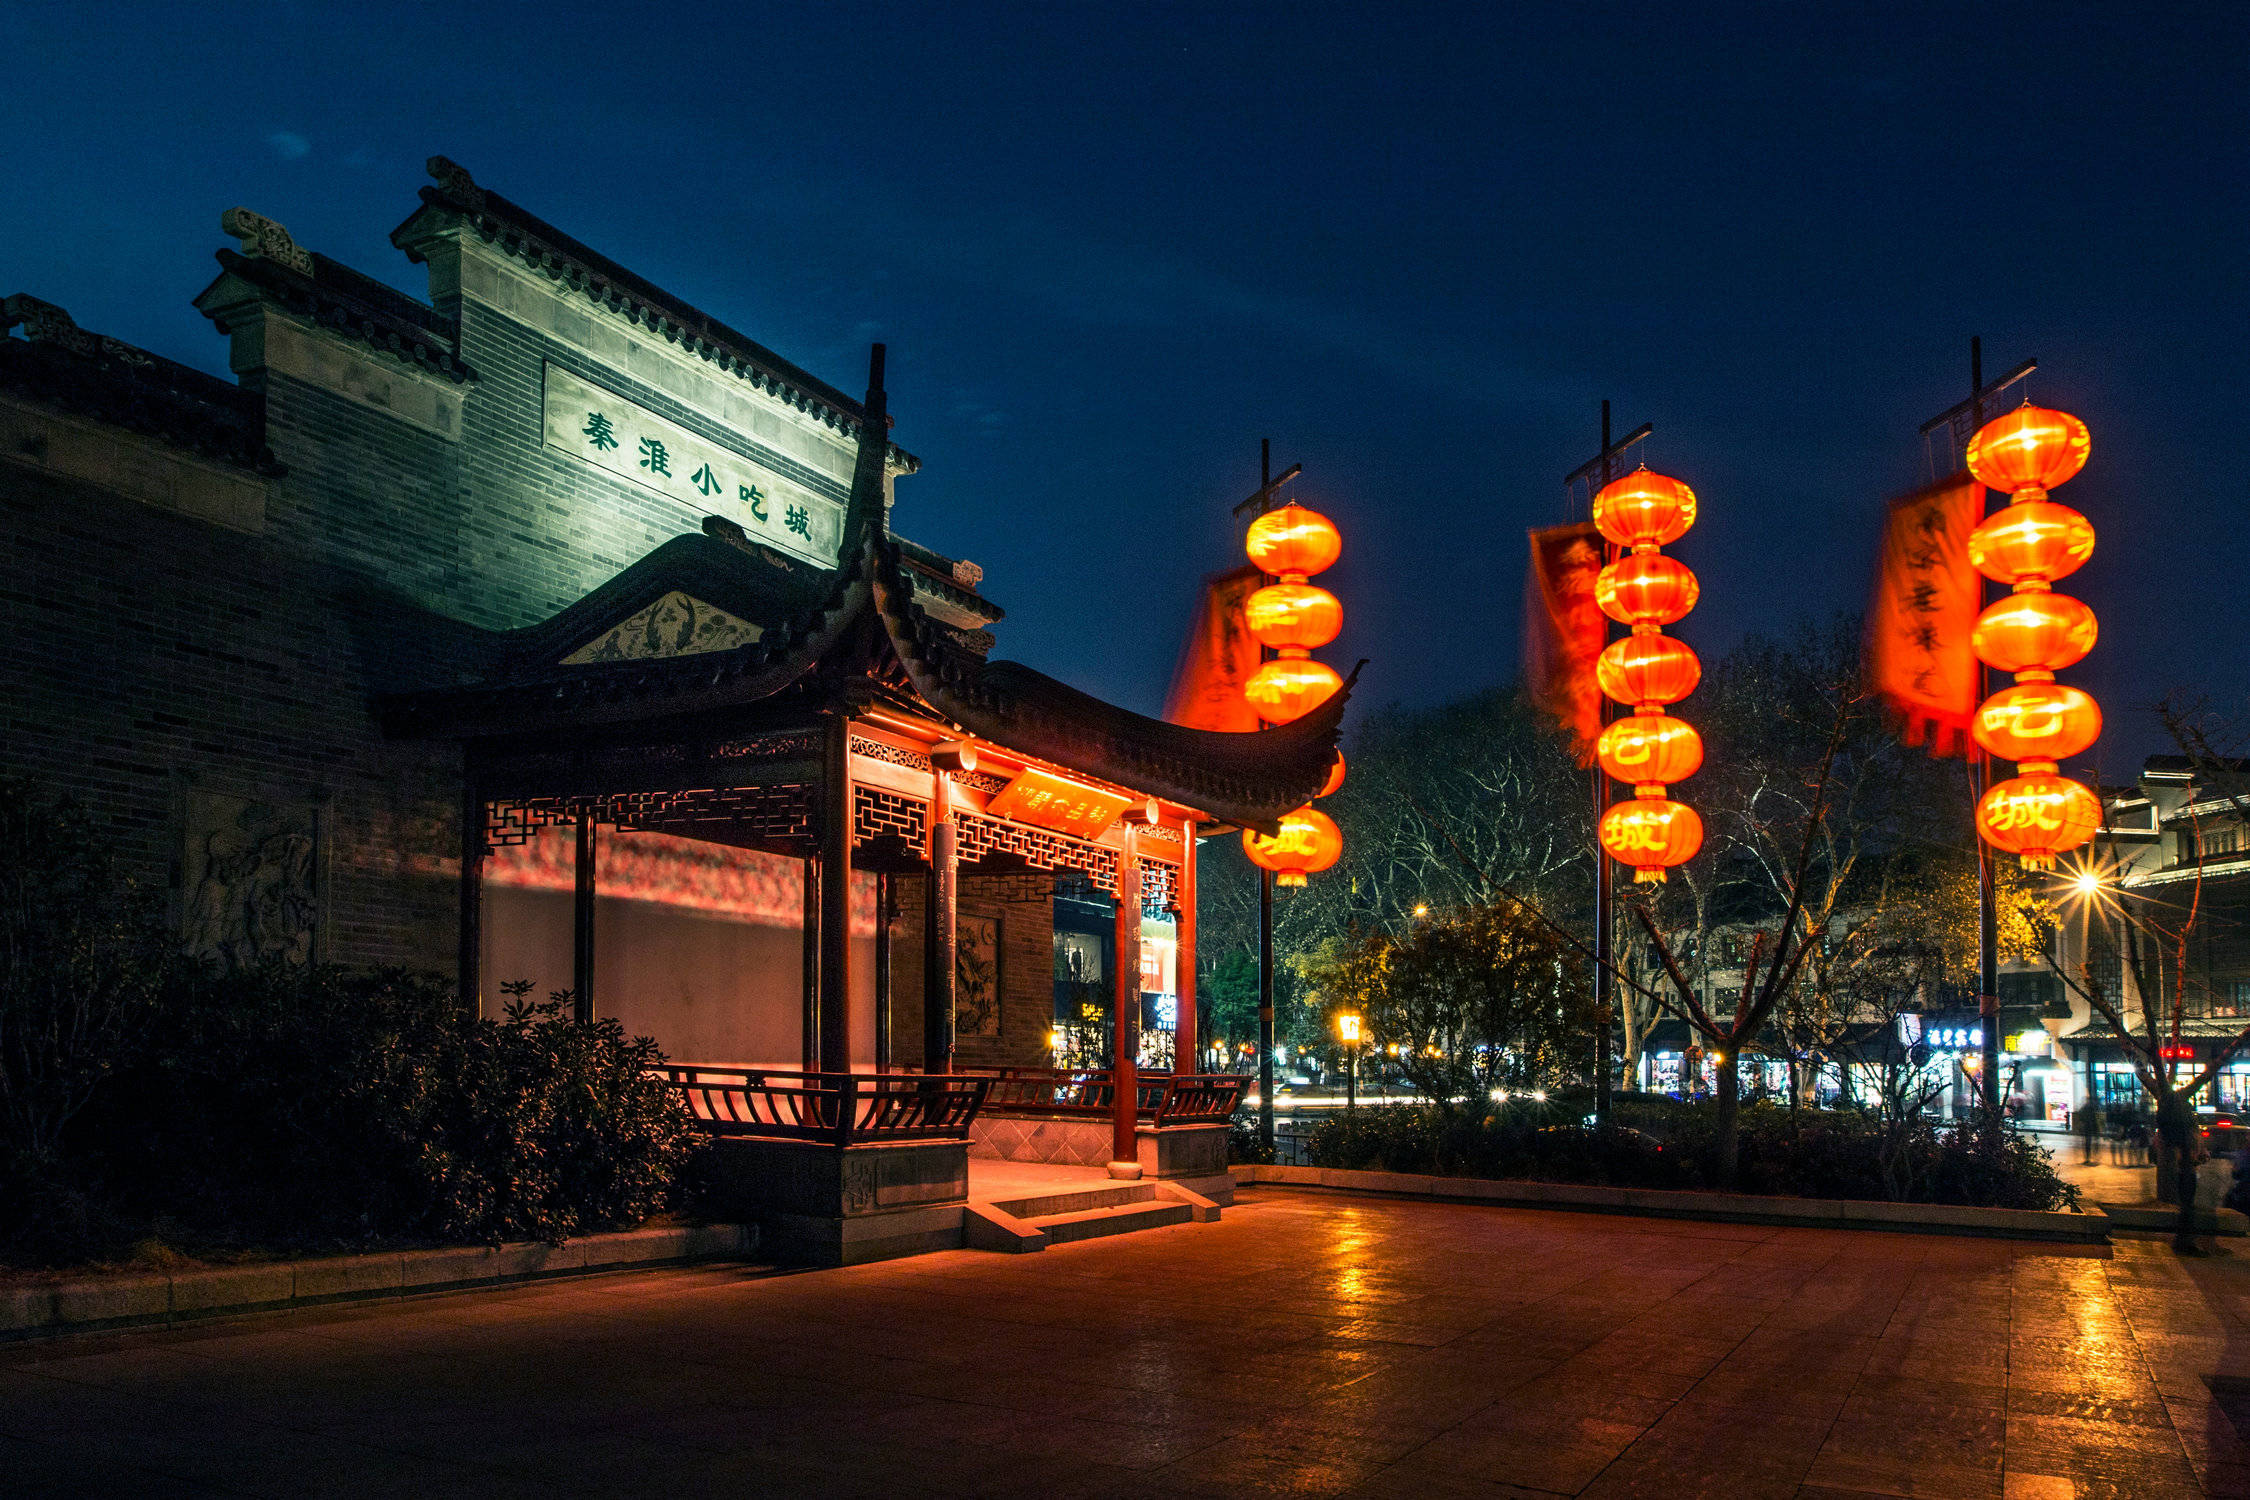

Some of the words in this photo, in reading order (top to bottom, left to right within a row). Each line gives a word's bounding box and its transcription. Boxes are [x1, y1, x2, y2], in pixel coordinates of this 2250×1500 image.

[582, 412, 812, 542] 秦淮小吃城
